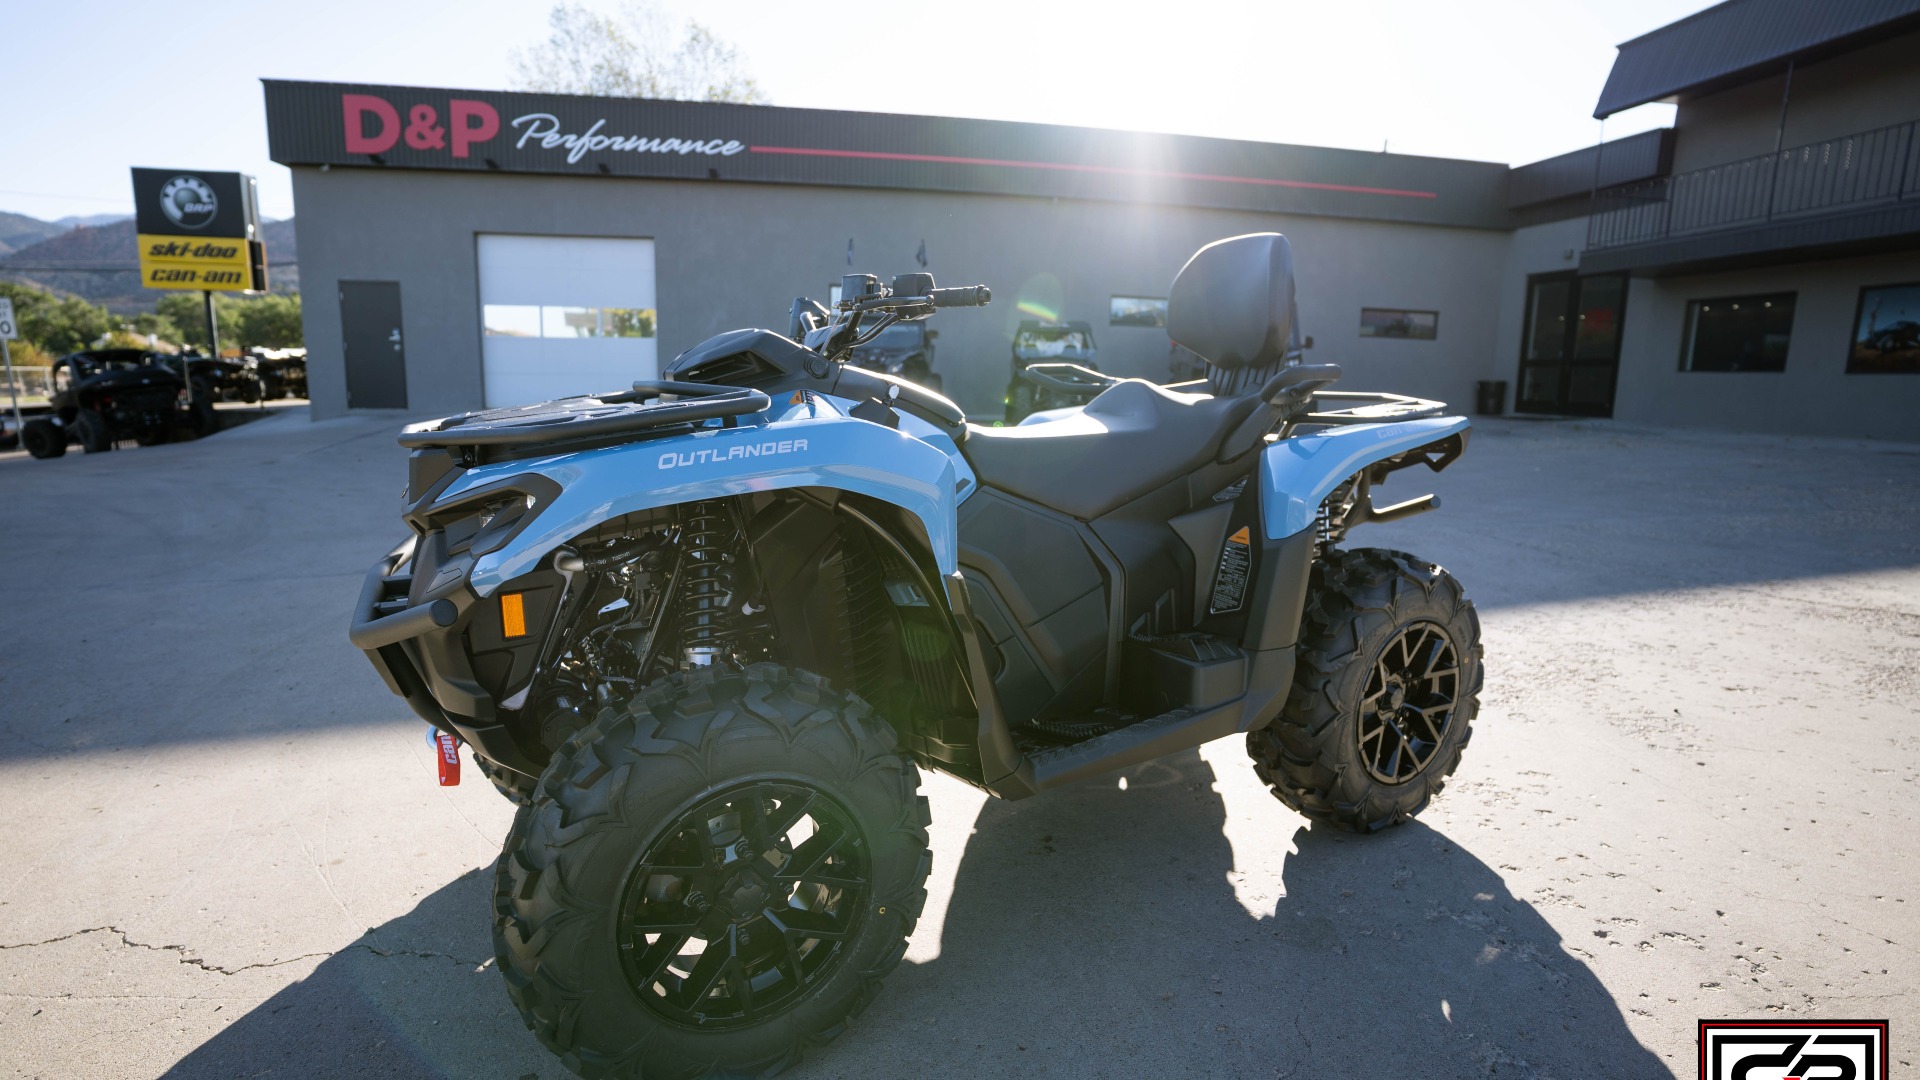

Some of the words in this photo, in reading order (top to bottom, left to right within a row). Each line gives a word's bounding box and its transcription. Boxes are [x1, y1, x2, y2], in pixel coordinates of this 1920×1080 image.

[341, 93, 500, 158] D&P
[511, 112, 744, 164] Performance
[148, 241, 238, 259] ski-doo
[149, 268, 242, 284] can-am
[657, 438, 809, 470] OUTLANDER
